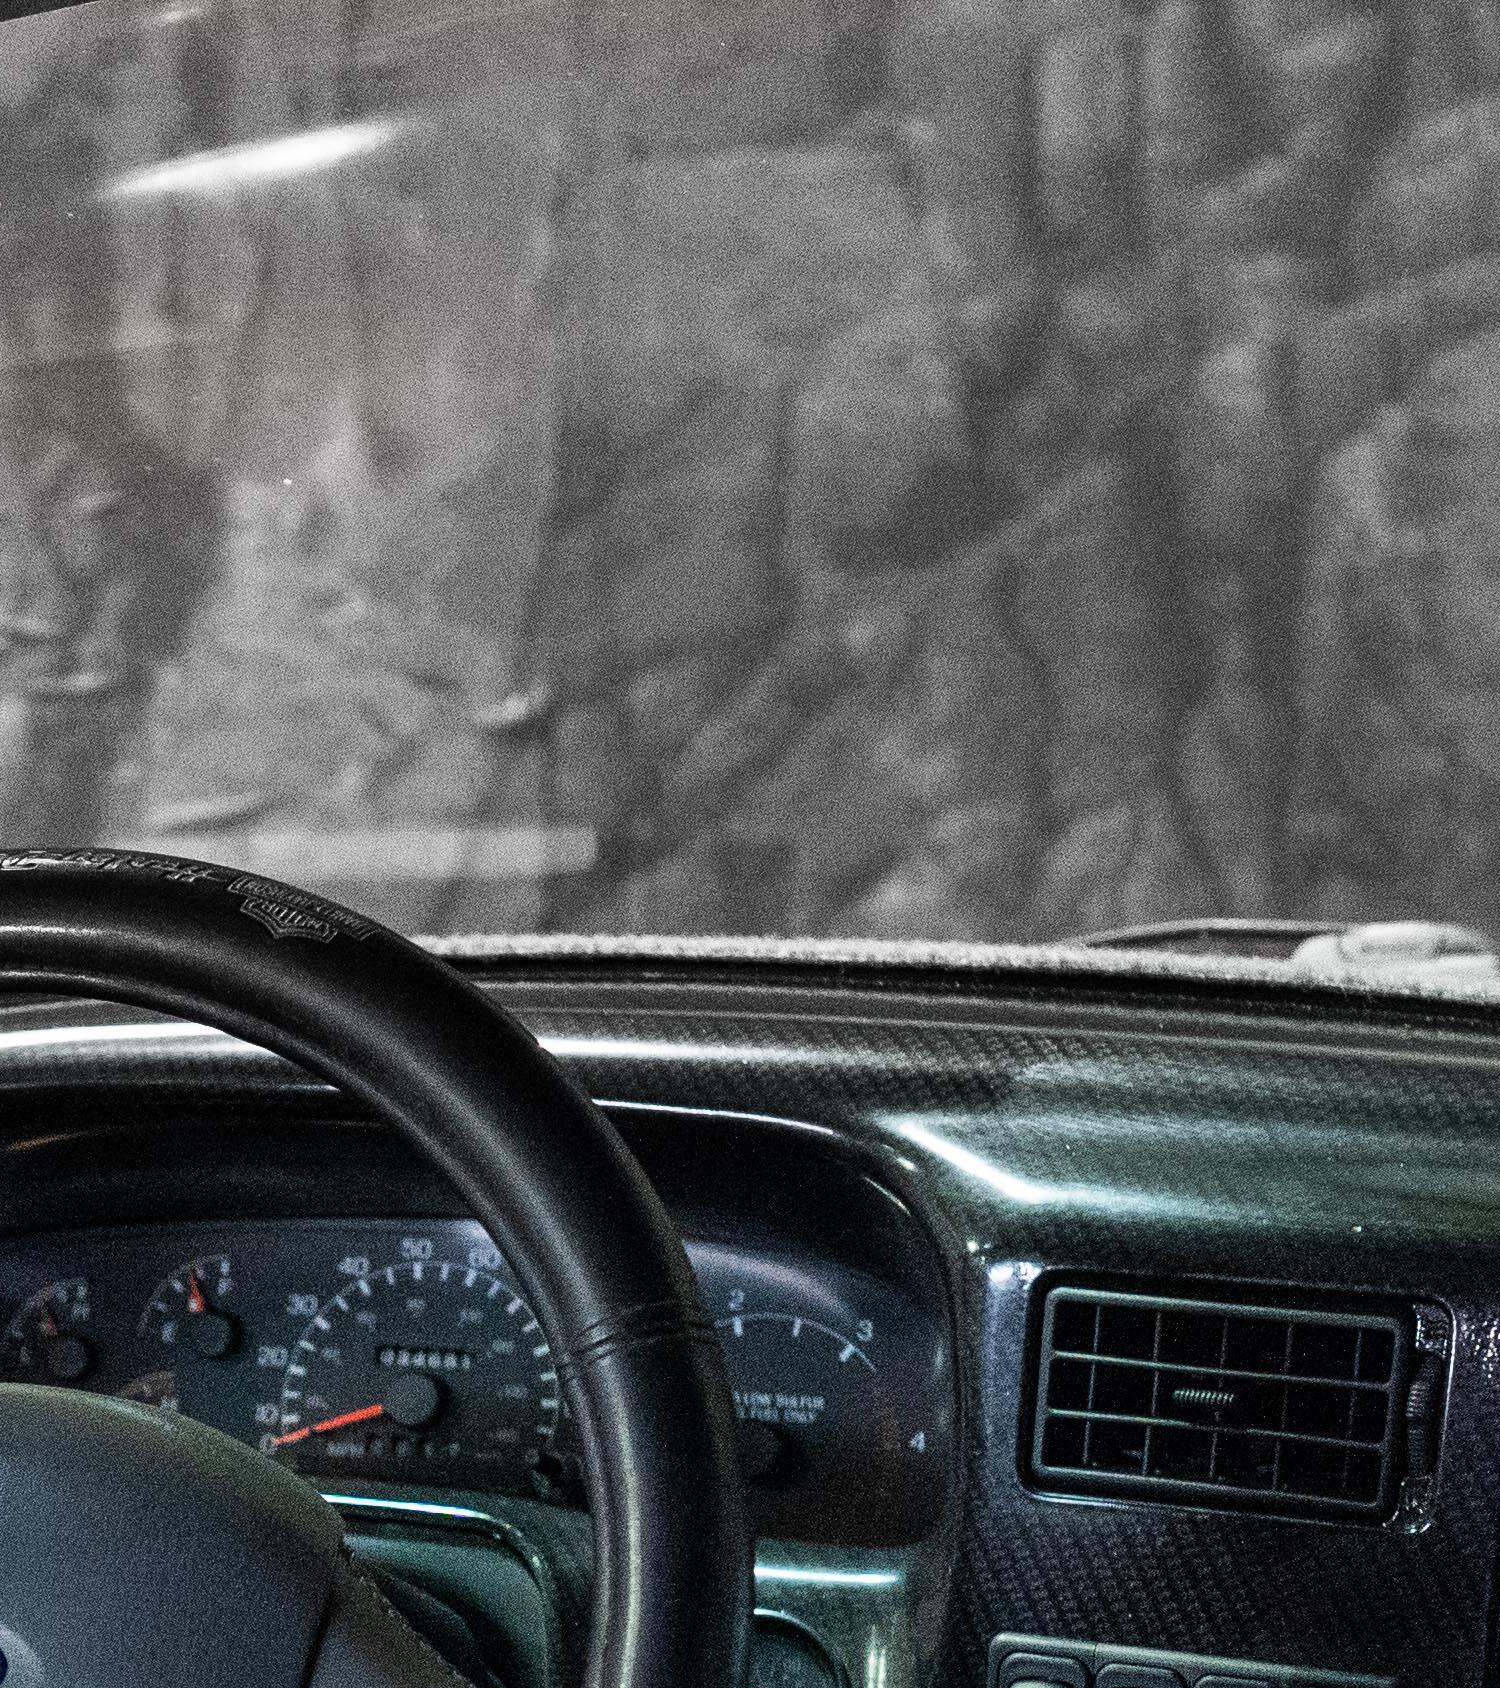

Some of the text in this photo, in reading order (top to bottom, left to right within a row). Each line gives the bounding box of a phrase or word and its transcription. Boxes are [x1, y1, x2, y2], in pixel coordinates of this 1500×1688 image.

[401, 1238, 433, 1260] 50
[337, 1256, 370, 1276] 40
[286, 1293, 319, 1316] 30
[728, 1289, 745, 1310] 2
[856, 1320, 873, 1342] 3
[258, 1346, 289, 1369] 20
[909, 1431, 927, 1453] 4
